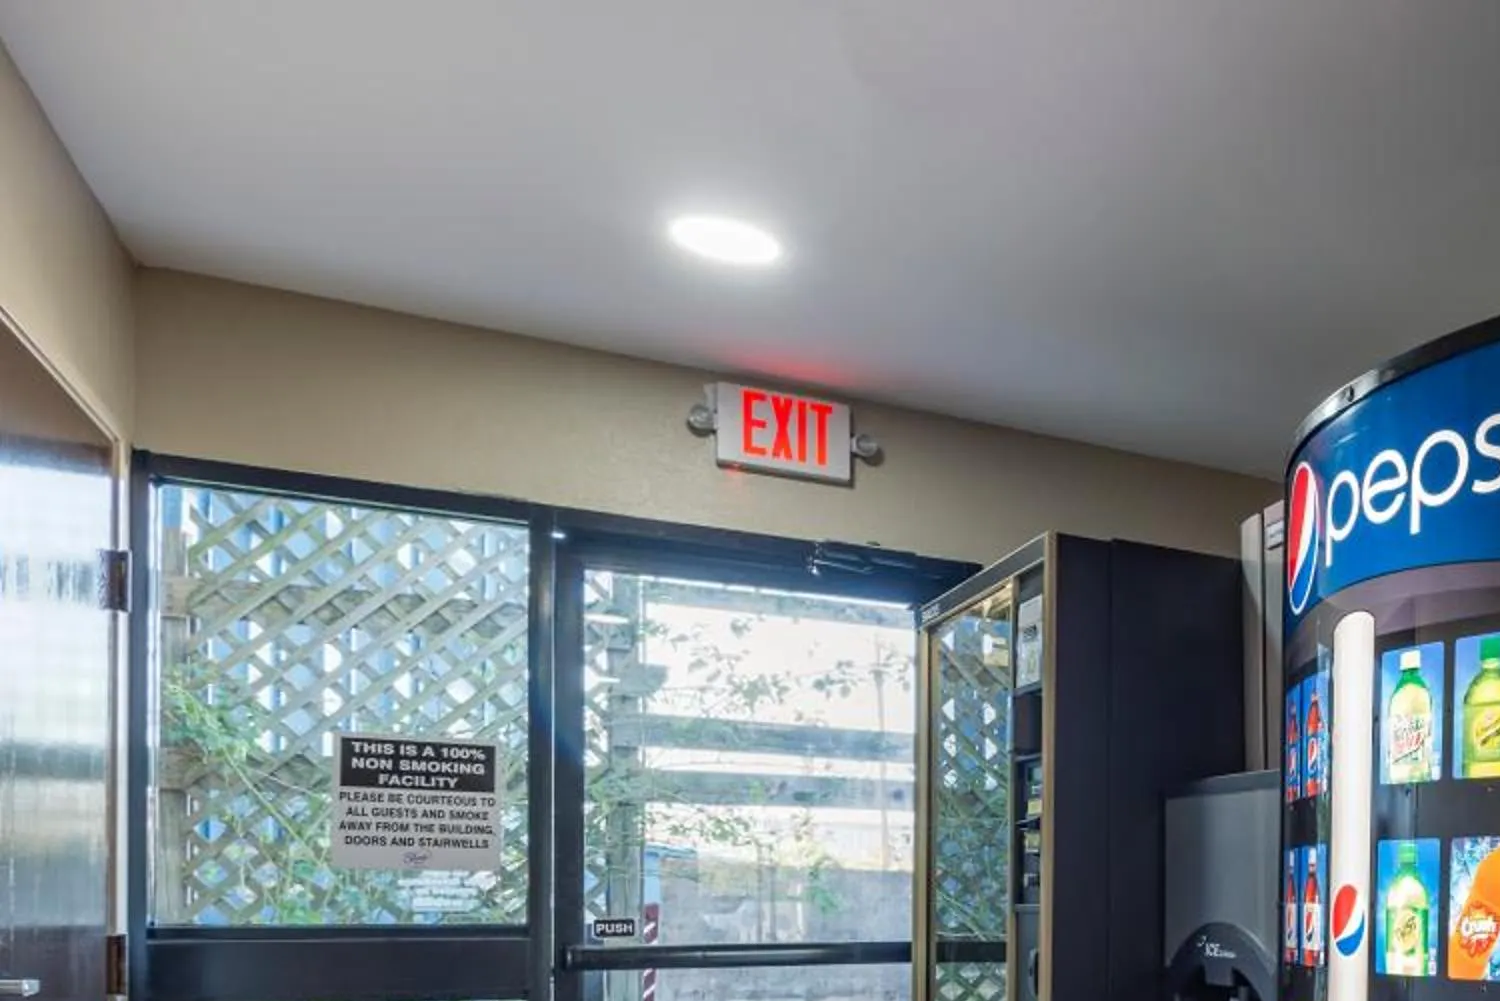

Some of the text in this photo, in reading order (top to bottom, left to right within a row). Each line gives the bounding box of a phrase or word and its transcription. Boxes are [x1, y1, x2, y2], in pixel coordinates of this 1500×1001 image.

[742, 388, 833, 466] EXIT
[351, 741, 486, 761] THIS IS A 100%
[351, 757, 485, 775] NON SMOKING
[378, 773, 459, 789] FACILITY
[339, 791, 497, 808] PLEASE BE COURTEOUS TO
[345, 806, 489, 821] ALL GUESTS AND SMOKE
[339, 820, 372, 831] AWAY
[375, 822, 410, 833] FROM
[413, 823, 435, 833] THE
[344, 835, 489, 849] DOORS AND STAIRWELLS
[596, 922, 634, 934] PUSH
